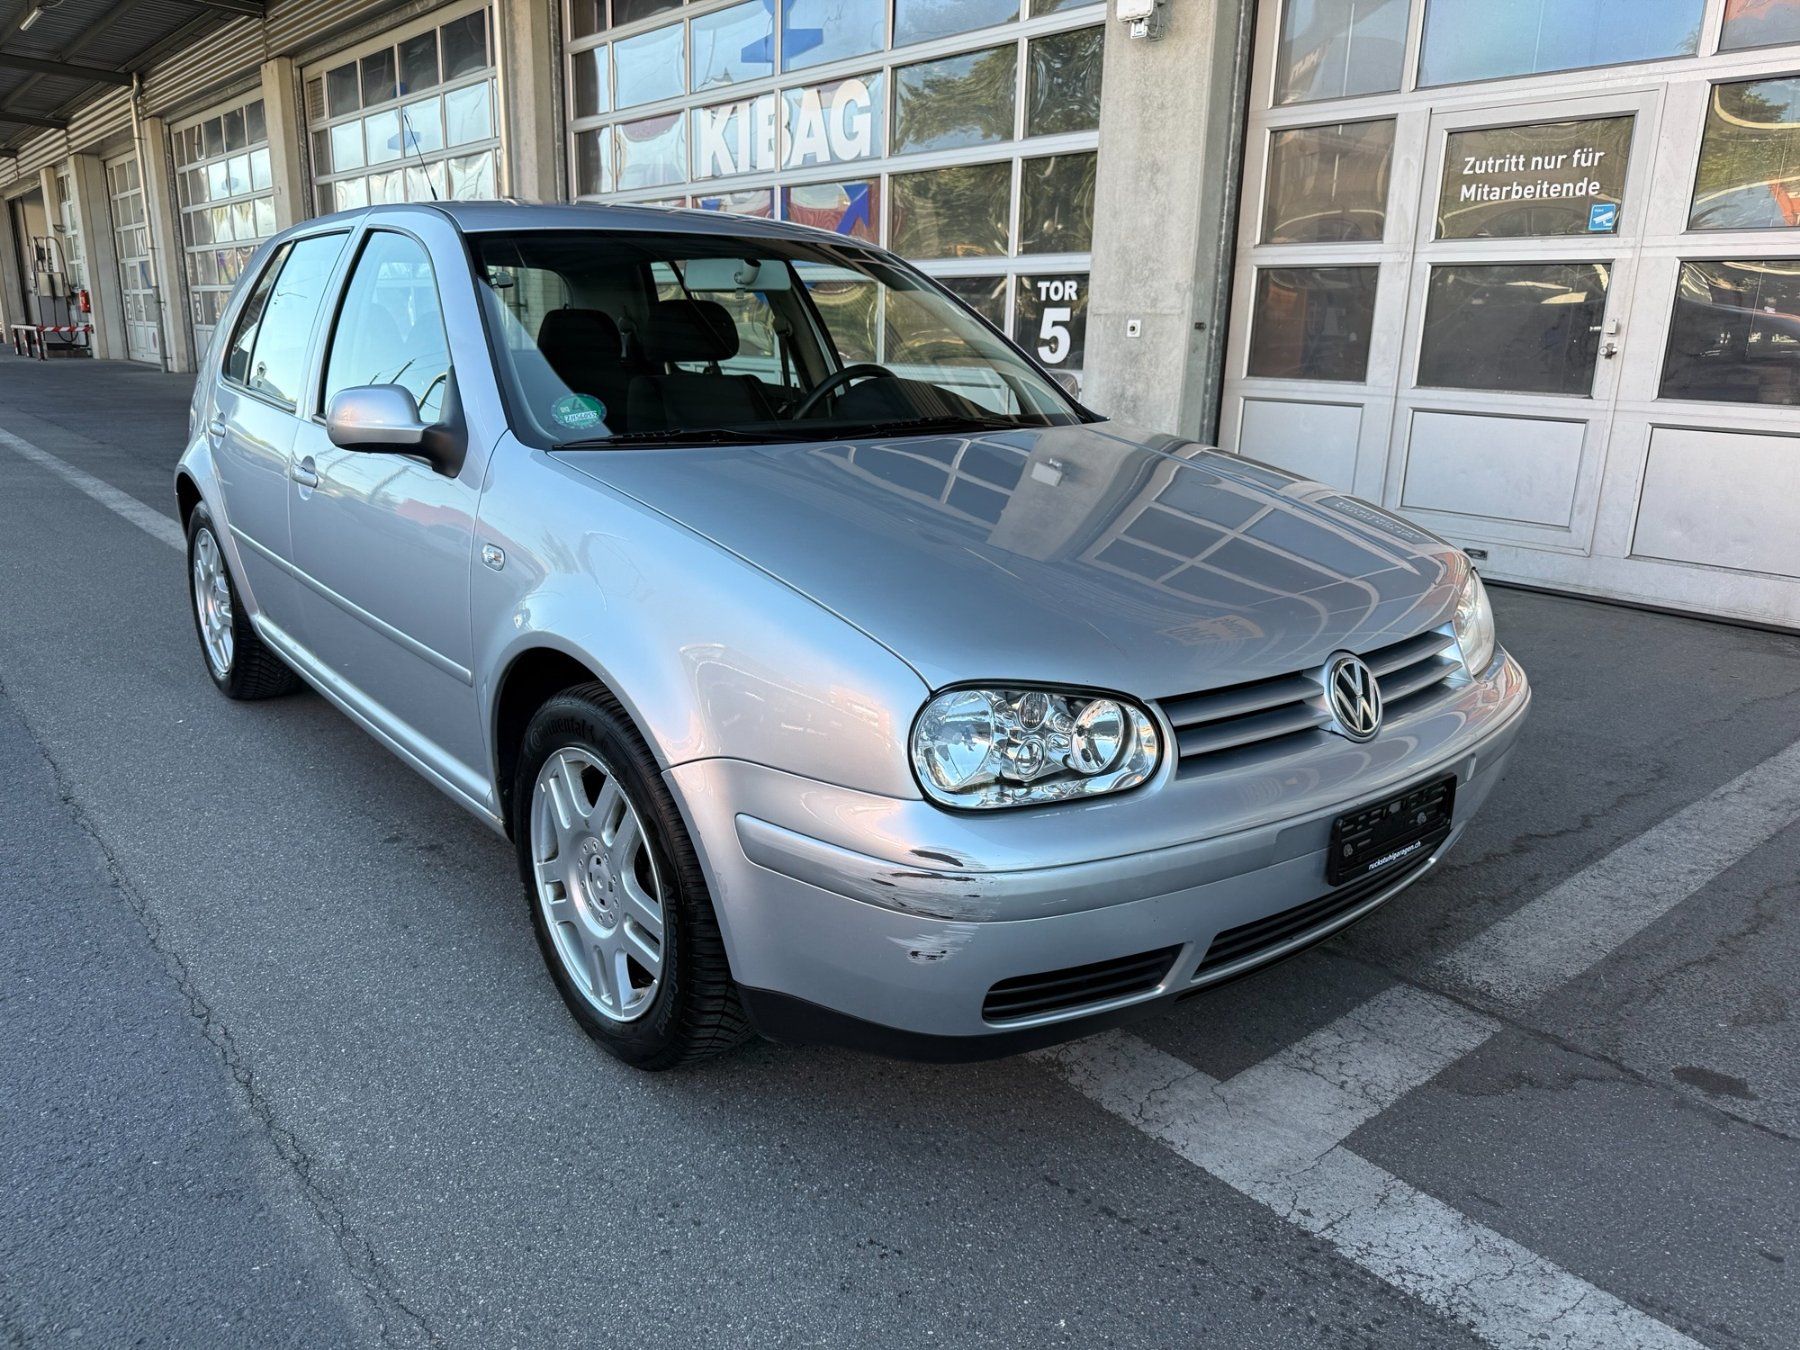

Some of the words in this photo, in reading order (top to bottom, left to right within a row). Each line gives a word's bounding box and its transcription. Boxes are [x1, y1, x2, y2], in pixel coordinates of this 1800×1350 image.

[700, 79, 872, 178] KIBAG
[1462, 154, 1525, 175] Zutritt
[1530, 153, 1567, 171] nur
[1571, 147, 1606, 168] für
[1460, 177, 1600, 202] Mitarbeitende
[1037, 280, 1078, 302] TOR
[1037, 307, 1072, 365] 5
